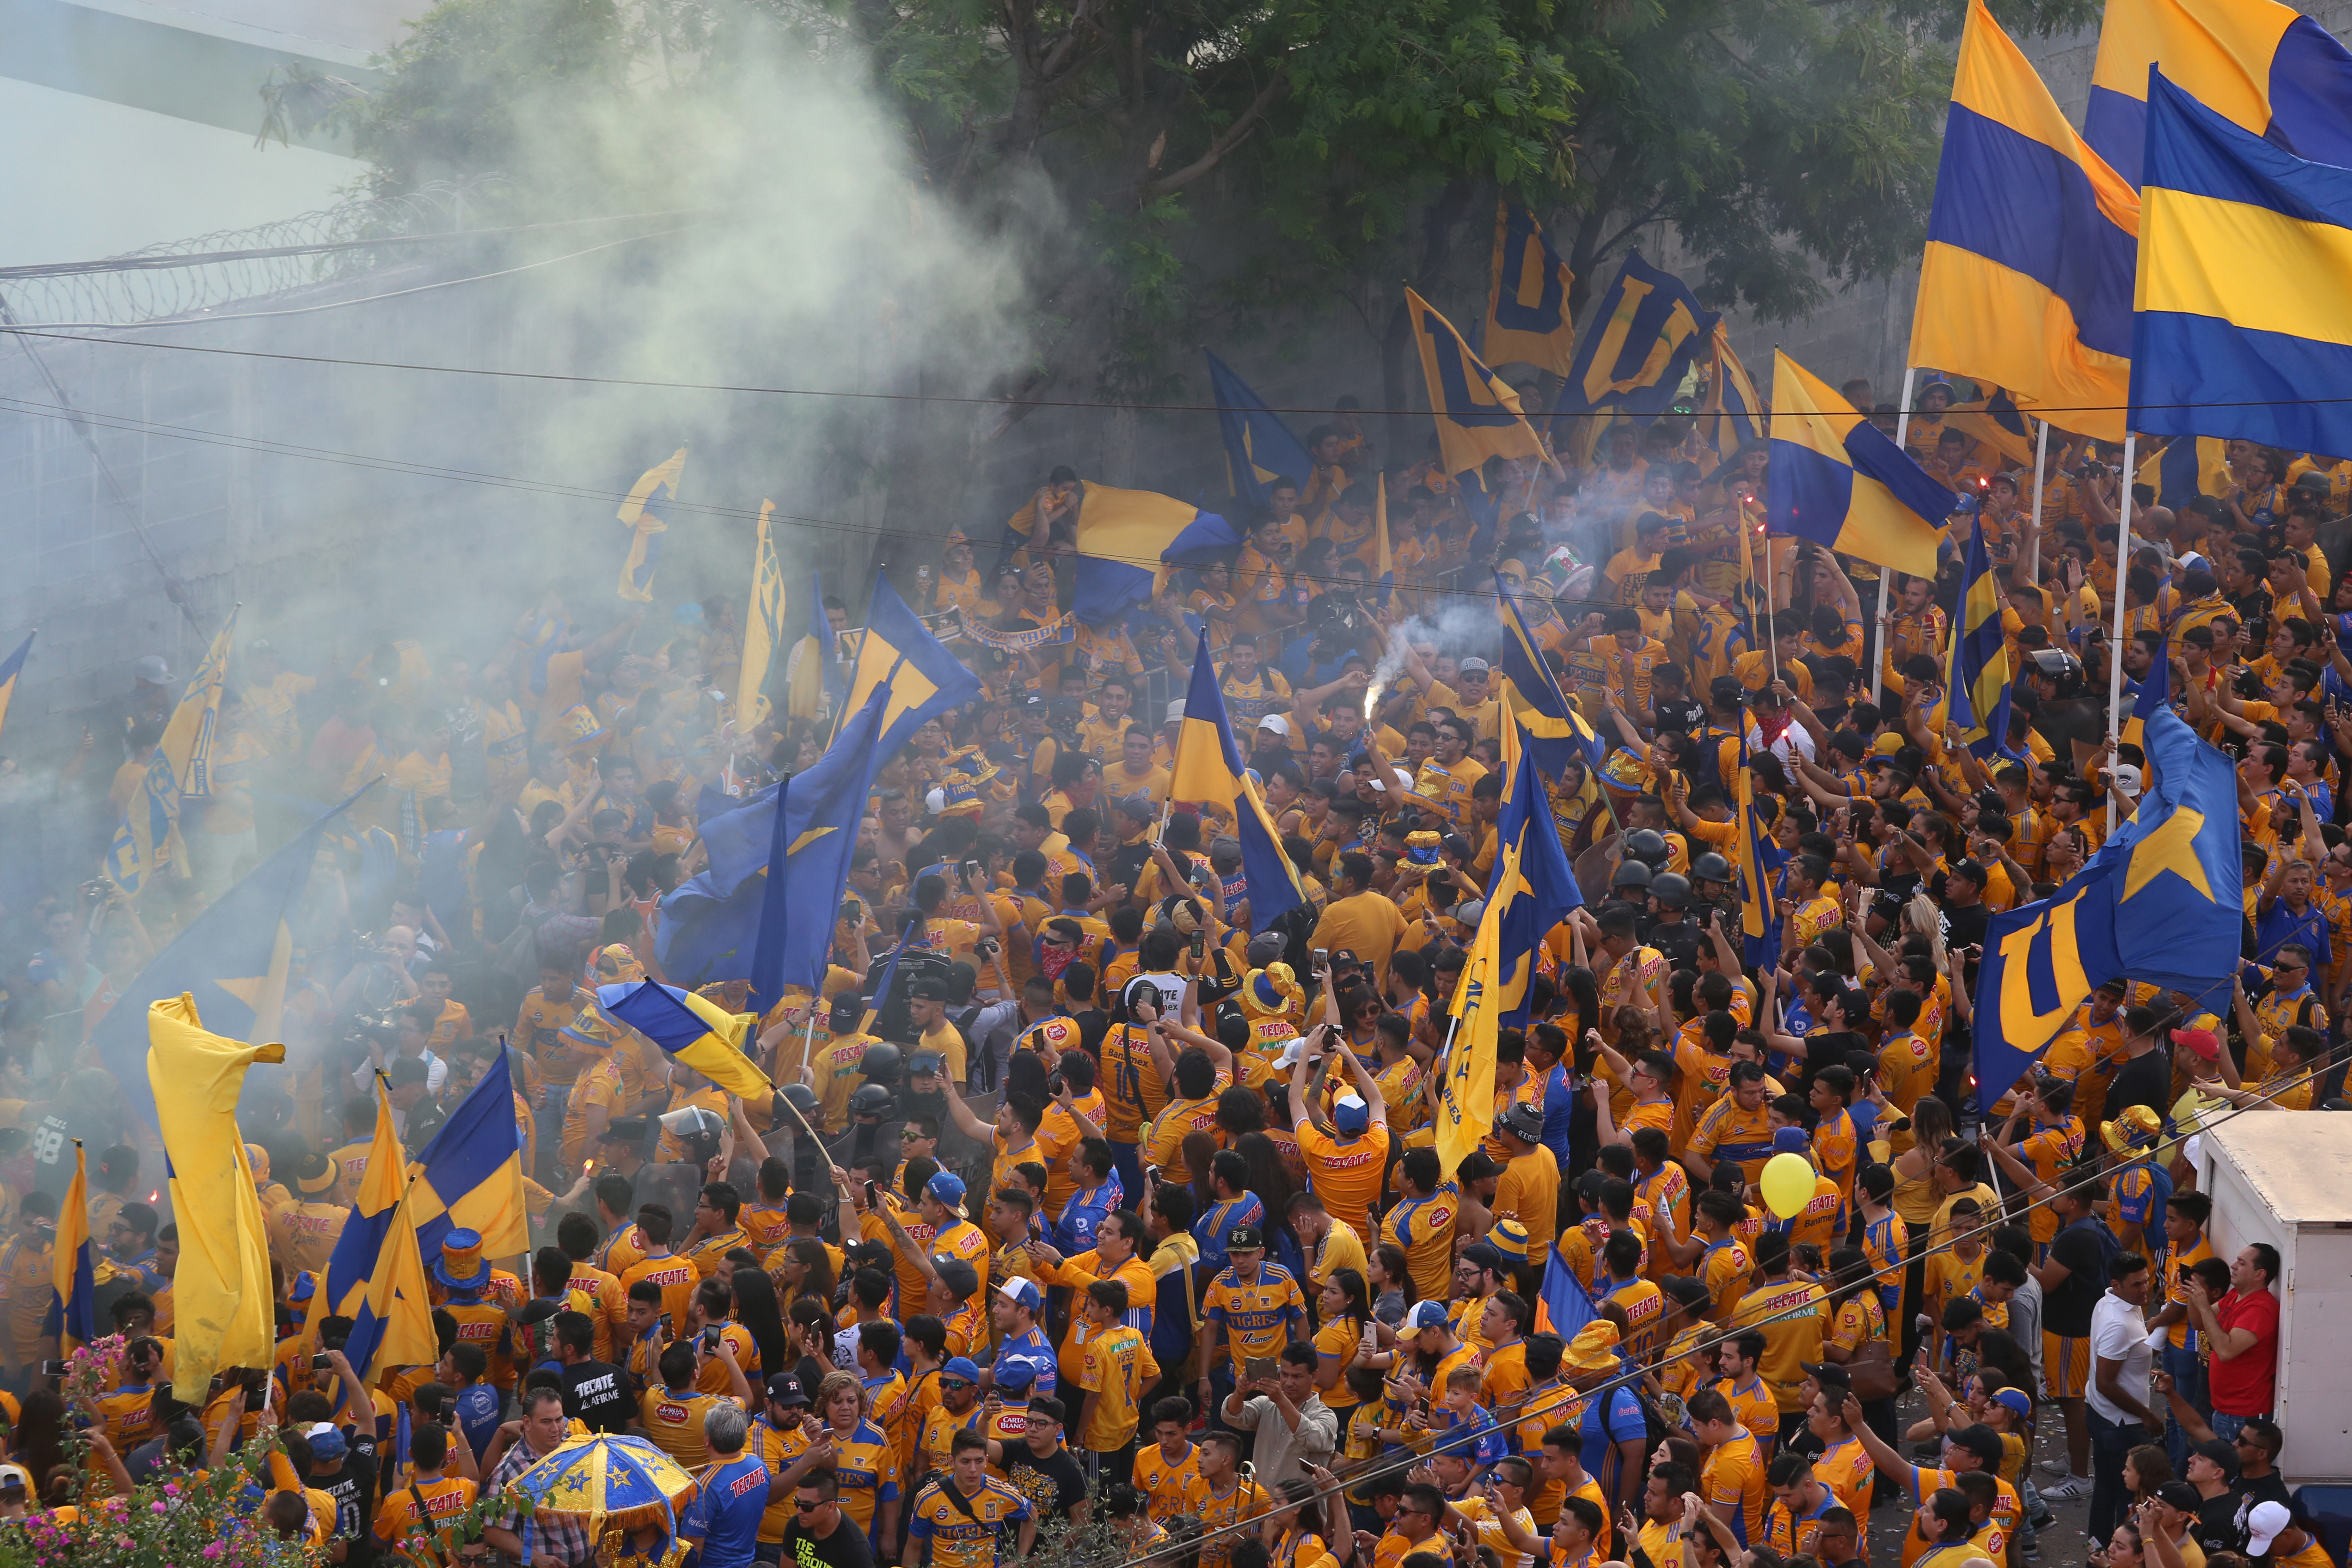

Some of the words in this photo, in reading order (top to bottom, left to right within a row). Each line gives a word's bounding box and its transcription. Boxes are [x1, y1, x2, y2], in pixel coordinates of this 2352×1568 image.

[1816, 906, 1841, 929] TECATE
[795, 1029, 828, 1041] AFIME
[1049, 1029, 1068, 1038] BLANCA
[1258, 1023, 1293, 1037] TECATE
[1911, 1042, 1923, 1050] CARTA
[1912, 1046, 1927, 1054] BLANCA
[1911, 1057, 1934, 1074] Baname
[1191, 1112, 1218, 1131] TECA
[34, 1126, 64, 1165] 98
[1826, 1147, 1846, 1157] Coca-Cola
[1324, 1152, 1371, 1169] TECATE
[1664, 1169, 1684, 1197] TECATE
[1806, 1194, 1836, 1216] TECATE
[1239, 1201, 1262, 1225] TECATE
[1432, 1213, 1449, 1225] BLANCA
[1433, 1209, 1444, 1218] CARTA
[1804, 1213, 1835, 1227] Banamex
[282, 1212, 332, 1233] TECATE
[291, 1232, 319, 1246] PZARRO
[904, 1224, 936, 1240] TECA
[1202, 1248, 1219, 1260] Coca-Cola
[646, 1268, 689, 1286] TECATE
[1628, 1294, 1659, 1321] TECATE
[1765, 1290, 1812, 1311] TECATE
[1229, 1313, 1277, 1328] TIGRES
[458, 1323, 494, 1338] CATE
[1835, 1329, 1856, 1341] Coca-Cola
[1250, 1335, 1273, 1343] CEMEX
[576, 1374, 615, 1398] TECATE
[591, 1389, 619, 1406] AFIRME
[659, 1409, 685, 1420] BLANCA
[663, 1405, 684, 1415] CARTA
[1617, 1406, 1638, 1417] Coca-Cola
[121, 1409, 148, 1427] TECA
[1753, 1415, 1774, 1425] Coca-Cola
[731, 1466, 765, 1498] TECATE
[840, 1474, 865, 1485] RES
[340, 1490, 361, 1504] FIRME
[1719, 1486, 1740, 1497] Coca-Cola
[406, 1490, 463, 1519] TCATE
[1991, 1495, 2011, 1512] ATE
[688, 1517, 708, 1528] Coca-Cola
[936, 1522, 996, 1540] TIGRES
[796, 1538, 815, 1556] THE
